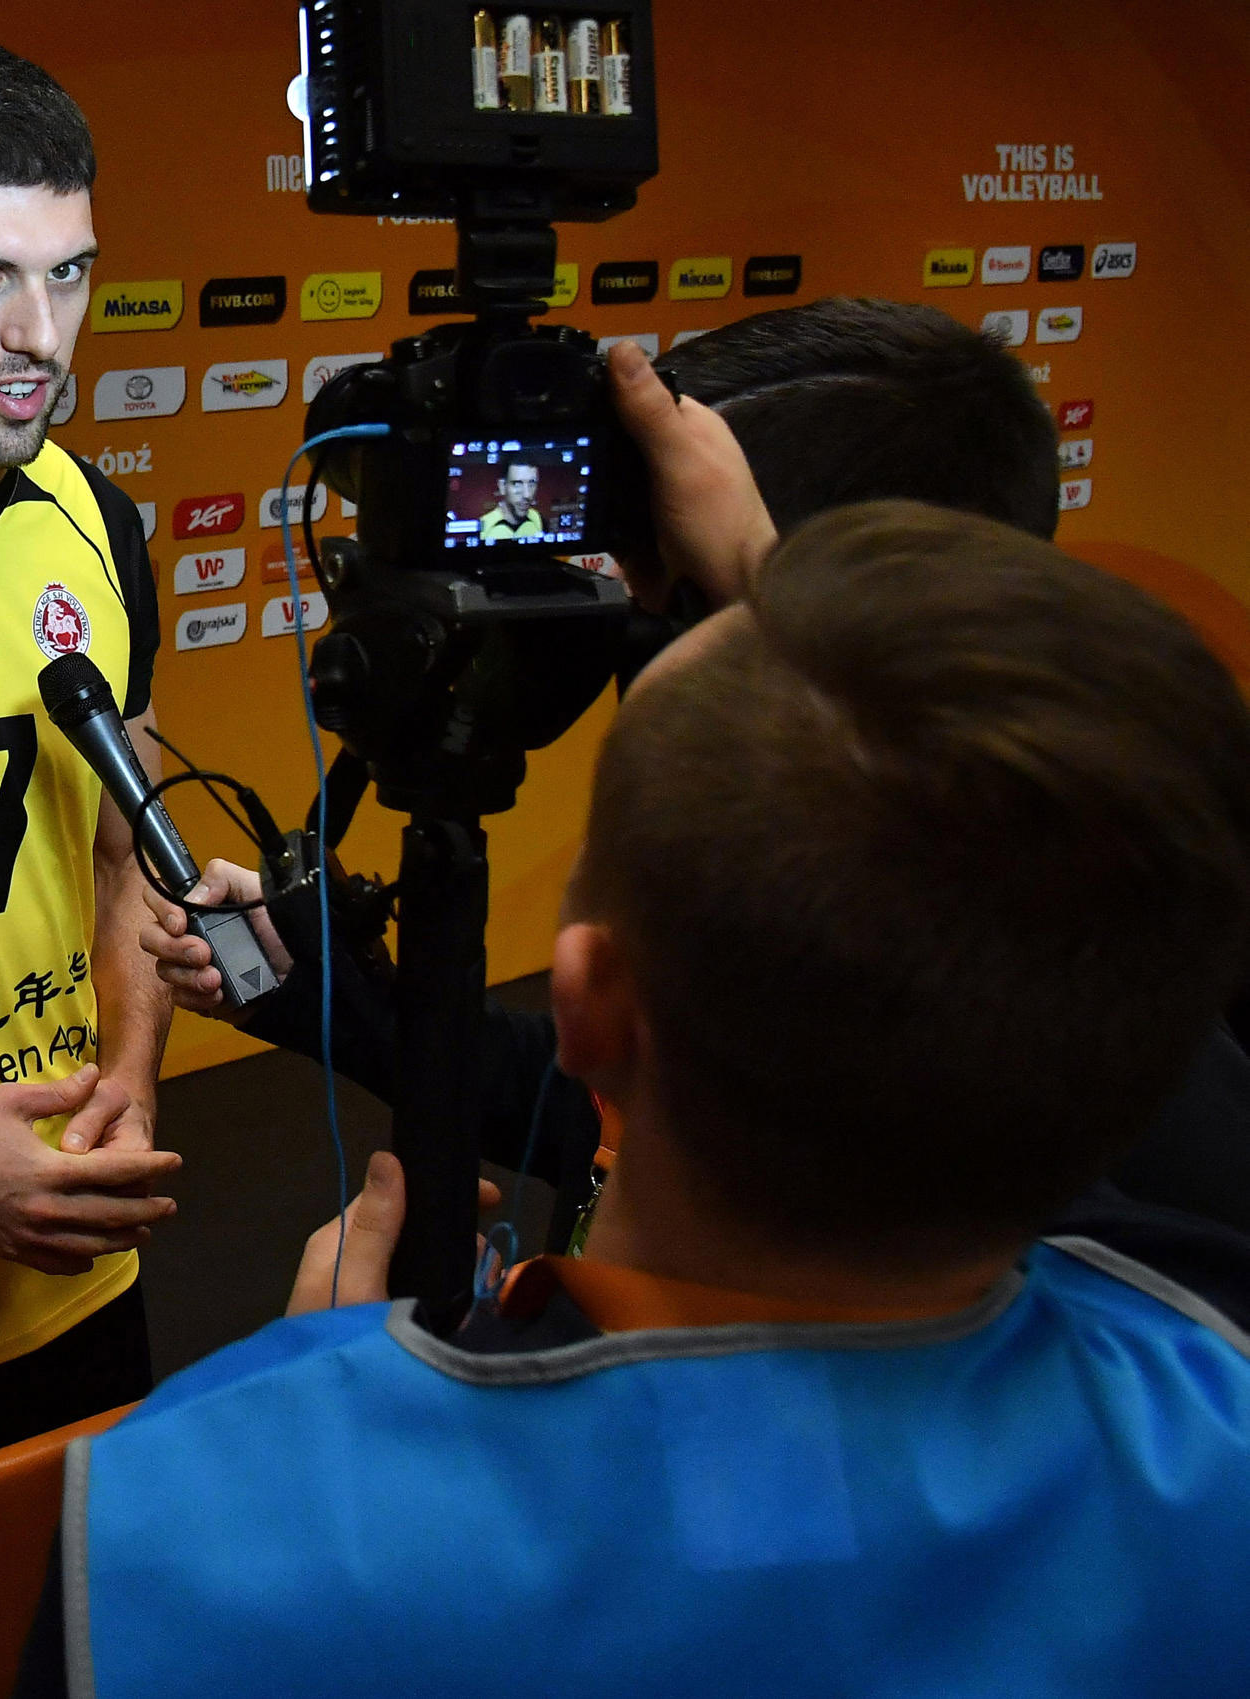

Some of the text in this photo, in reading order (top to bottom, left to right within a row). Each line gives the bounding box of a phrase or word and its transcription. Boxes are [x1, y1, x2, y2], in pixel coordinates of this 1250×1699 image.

[995, 143, 1075, 172] THIS IS
[962, 174, 1103, 202] VOLLEYBALL
[210, 293, 276, 309] FIVB.COM
[123, 401, 156, 412] TOYOTA
[187, 503, 234, 532] ZET
[195, 557, 224, 581] WP
[36, 608, 45, 644] GOLDEN
[41, 594, 52, 606] AGE
[66, 595, 88, 641] VOLLEYBALL
